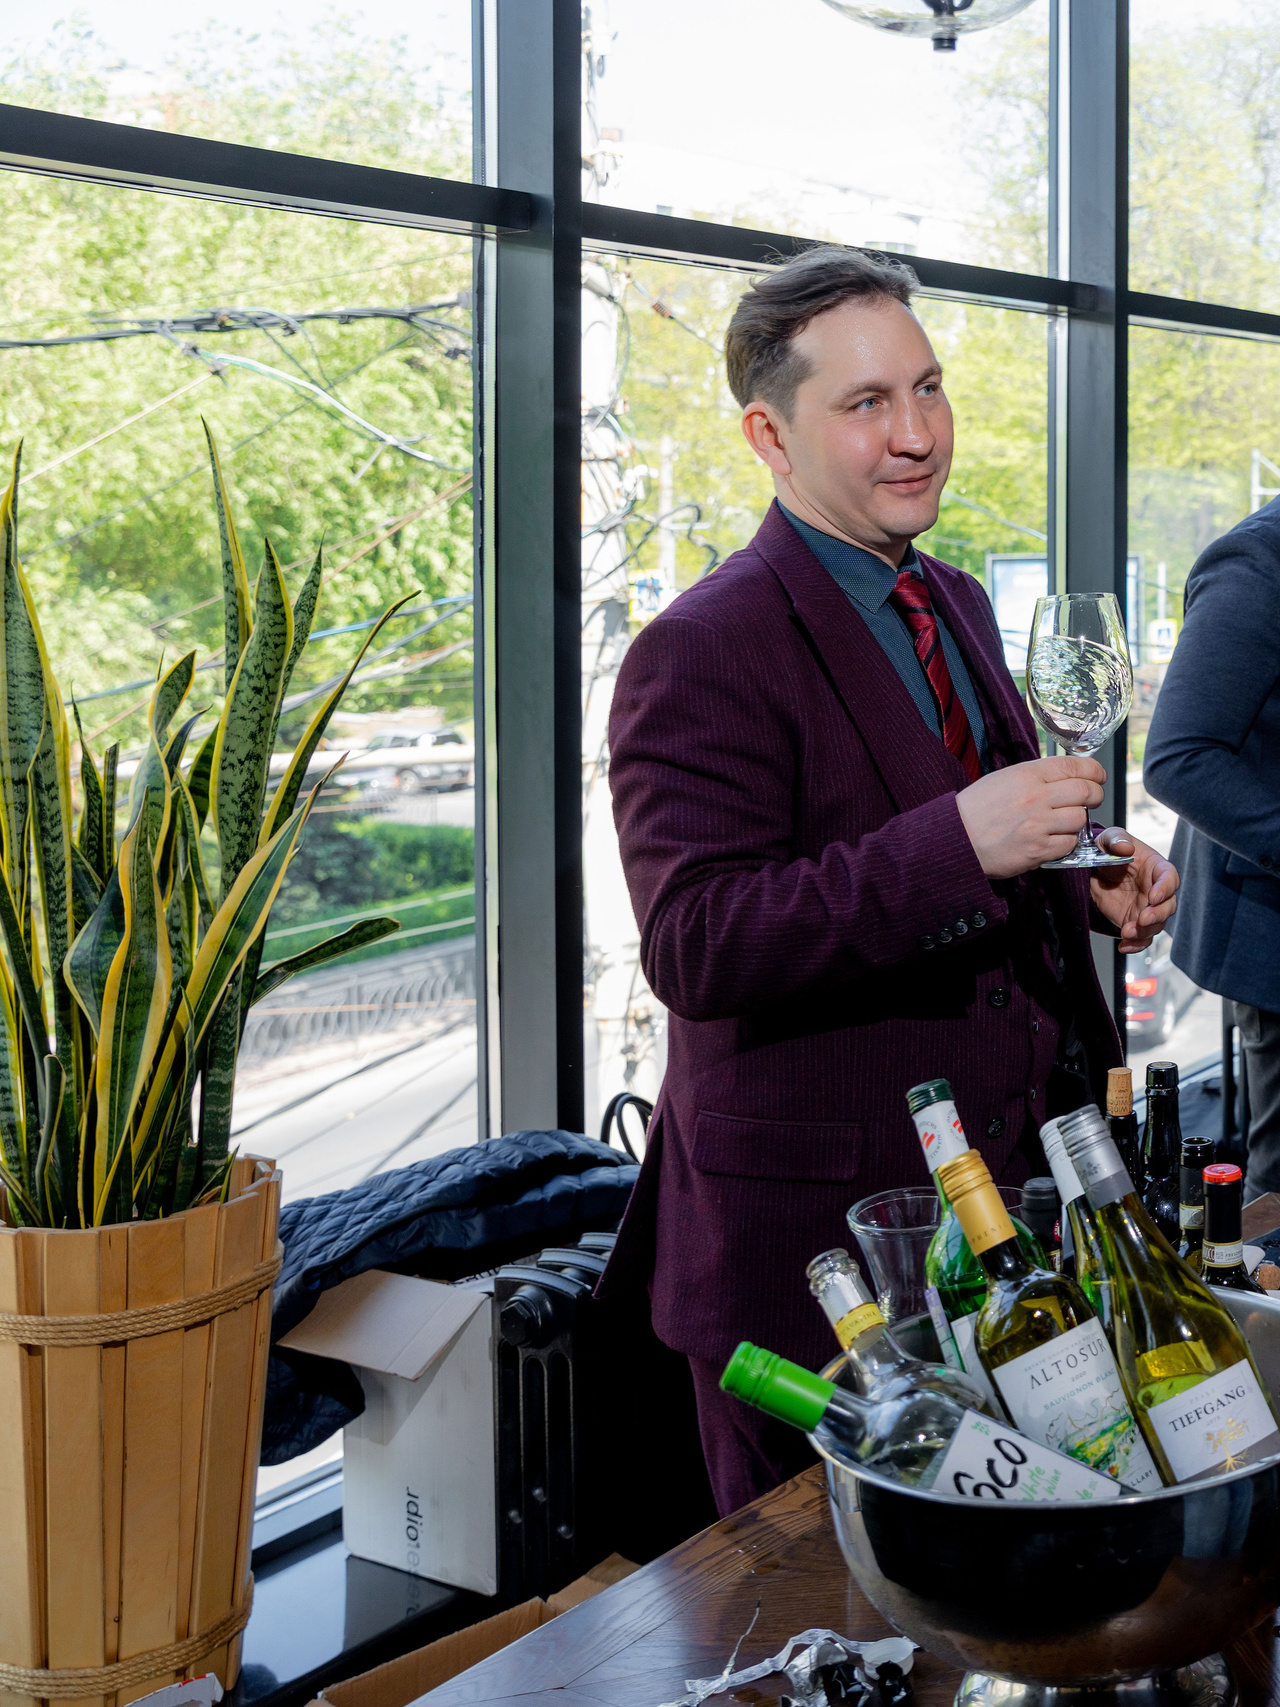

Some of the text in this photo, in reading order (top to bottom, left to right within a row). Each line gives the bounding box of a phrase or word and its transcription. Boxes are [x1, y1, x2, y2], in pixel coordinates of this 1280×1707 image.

[1027, 1337, 1108, 1390] ALTOSUR
[1070, 1370, 1088, 1383] 2020
[1043, 1367, 1117, 1411] SAUVIGNON BLANC
[1168, 1384, 1247, 1433] TIEFGANG
